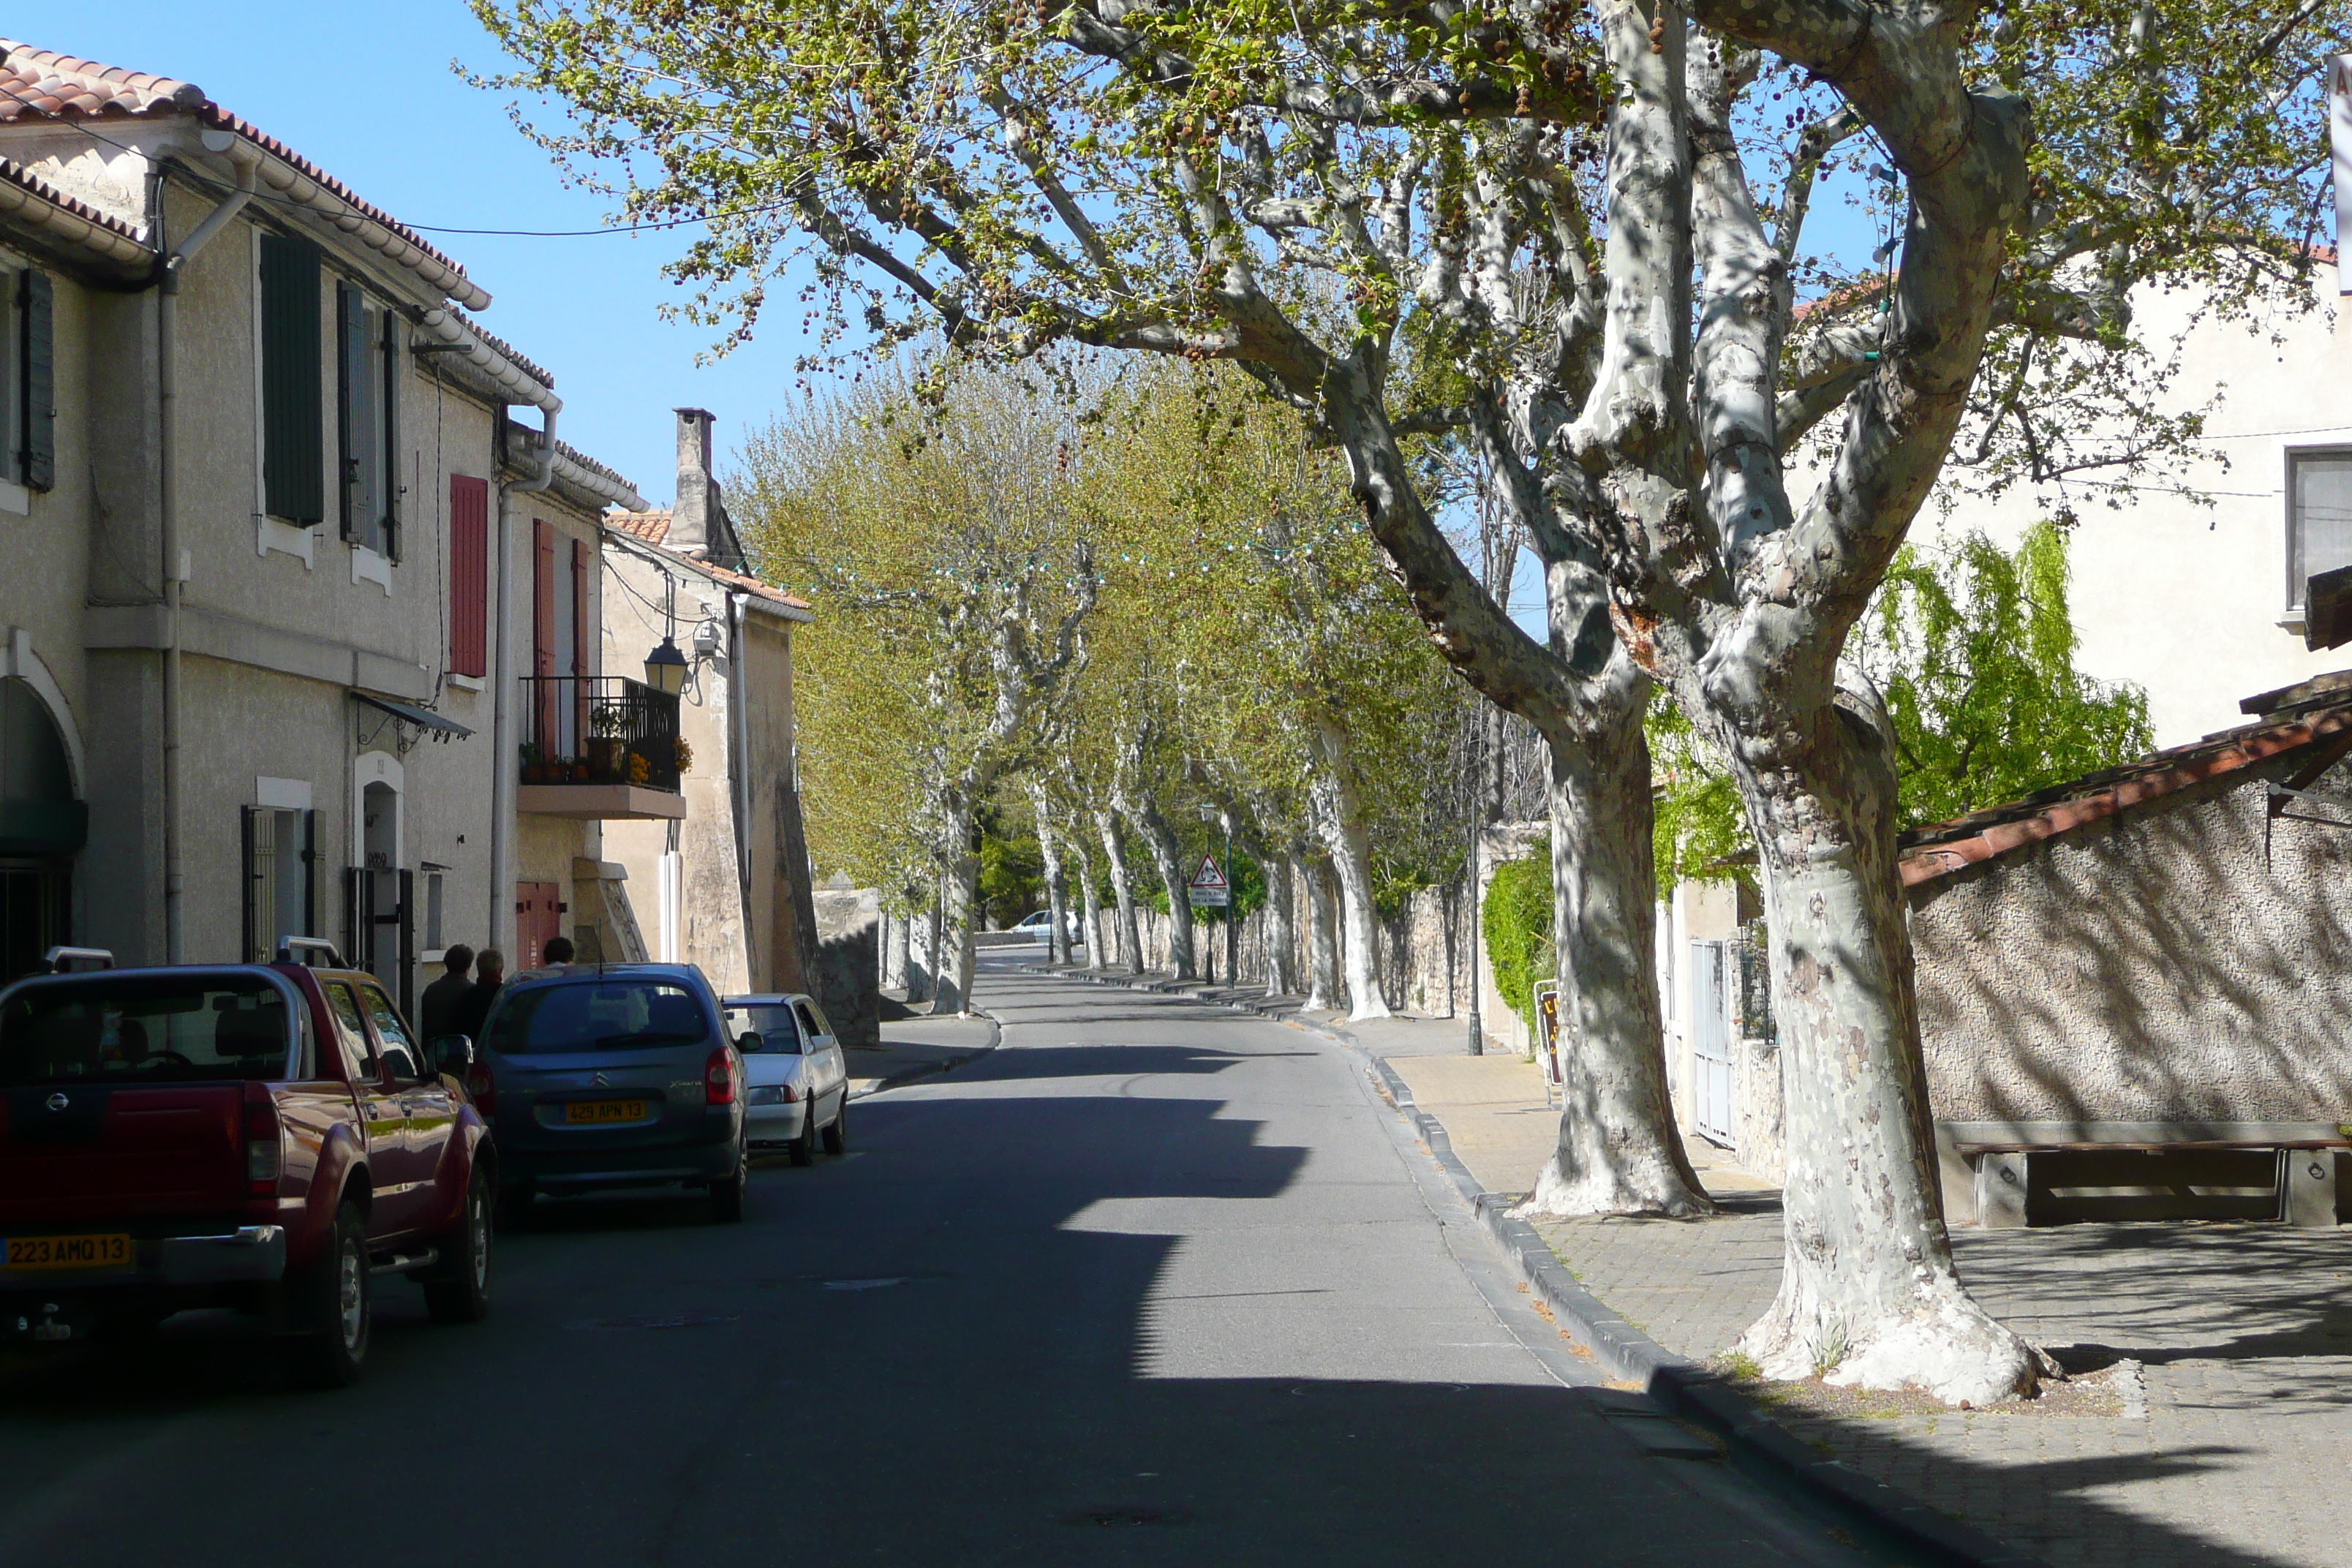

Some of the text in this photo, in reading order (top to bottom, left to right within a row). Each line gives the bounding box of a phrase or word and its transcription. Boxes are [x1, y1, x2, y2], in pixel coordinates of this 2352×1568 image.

[571, 1102, 641, 1120] 429 APN 13
[10, 1240, 50, 1263] 223
[101, 1237, 124, 1259] 13
